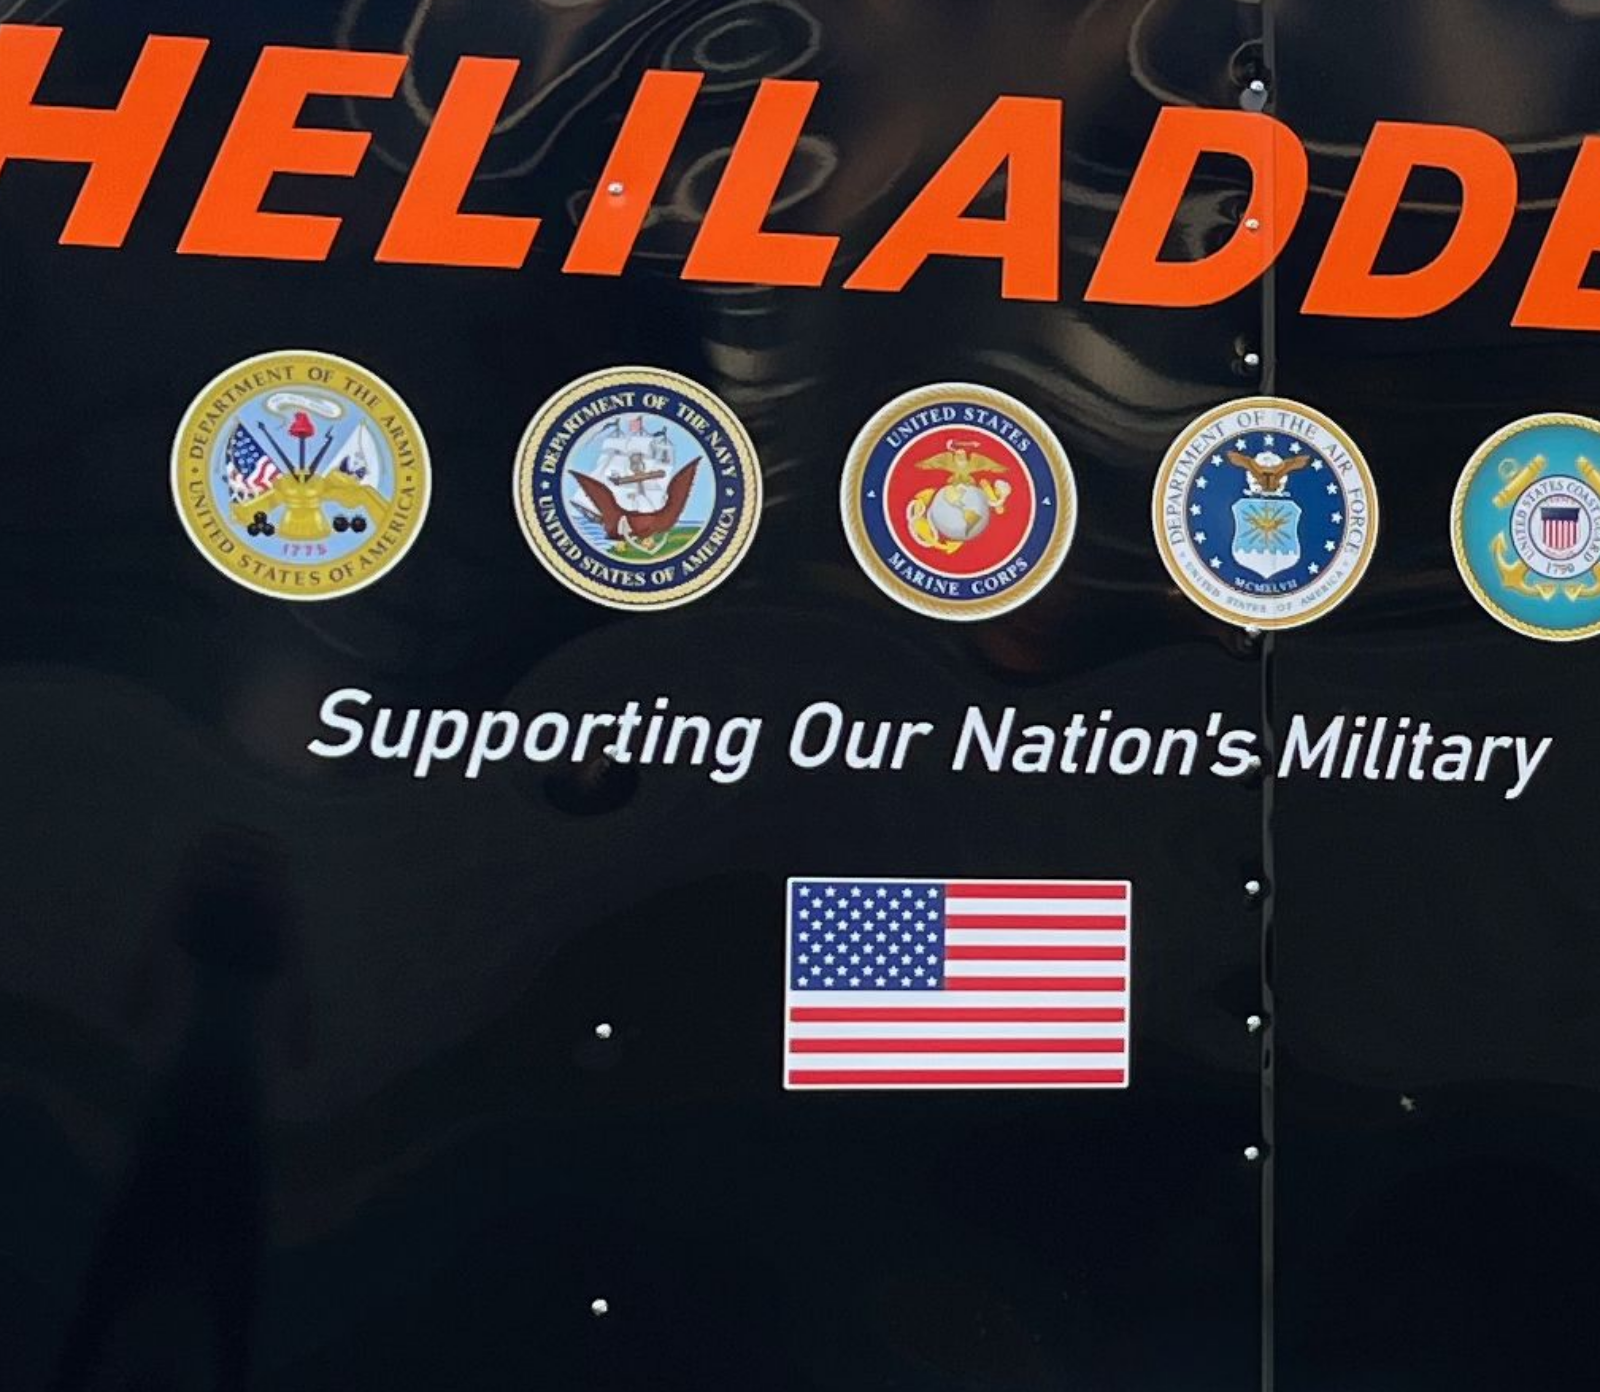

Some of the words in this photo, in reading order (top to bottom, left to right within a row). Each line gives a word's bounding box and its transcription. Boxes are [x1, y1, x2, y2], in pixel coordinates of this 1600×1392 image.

[189, 366, 295, 460] DEPARTMENT
[307, 367, 335, 383] OF
[344, 376, 381, 409] THE
[381, 414, 416, 467] ARMY
[541, 392, 635, 475] DEPARTMENT
[642, 393, 670, 410] OF
[677, 402, 708, 434] THE
[708, 430, 738, 478] NAVY
[886, 406, 957, 448] UNITED
[963, 407, 1031, 453] STATES
[1165, 420, 1225, 546] DEPARTMENT
[1237, 411, 1264, 427] OF
[1277, 412, 1319, 440] THE
[1322, 442, 1354, 474] AIR
[1522, 481, 1564, 508] STATES
[1567, 482, 1600, 514] COAST
[189, 480, 236, 554] UNITED
[237, 554, 321, 586] STATES
[329, 563, 355, 583] OF
[359, 486, 416, 570] AMERICA
[283, 543, 328, 557] 1775
[539, 495, 583, 562] UNITED
[579, 557, 646, 586] STATES
[651, 567, 676, 585] OF
[682, 507, 737, 574] AMERICA
[1515, 509, 1535, 561] UNITED
[889, 551, 960, 596] MARINE
[971, 557, 1028, 595] CORPS
[307, 688, 763, 784] Supporting
[789, 701, 934, 770] Our
[952, 706, 1256, 777] Nation's
[1277, 714, 1553, 800] Military
